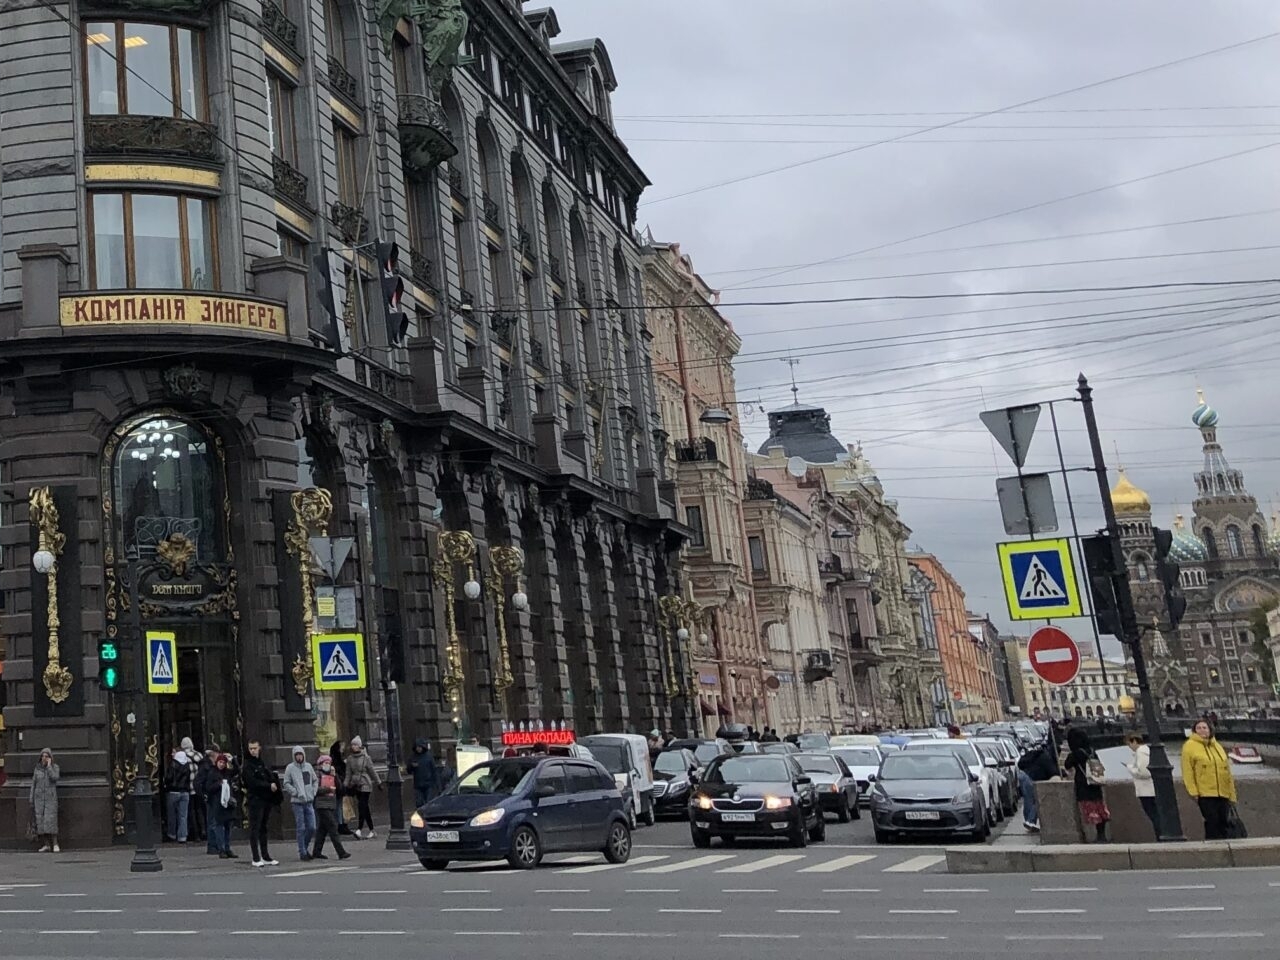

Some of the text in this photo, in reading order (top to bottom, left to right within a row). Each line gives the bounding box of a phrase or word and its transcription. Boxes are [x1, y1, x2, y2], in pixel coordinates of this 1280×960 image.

[74, 298, 277, 330] КОМПАНІЯ ЗИНГЕРЪ
[503, 730, 575, 745] ПИНА КОЛАДА
